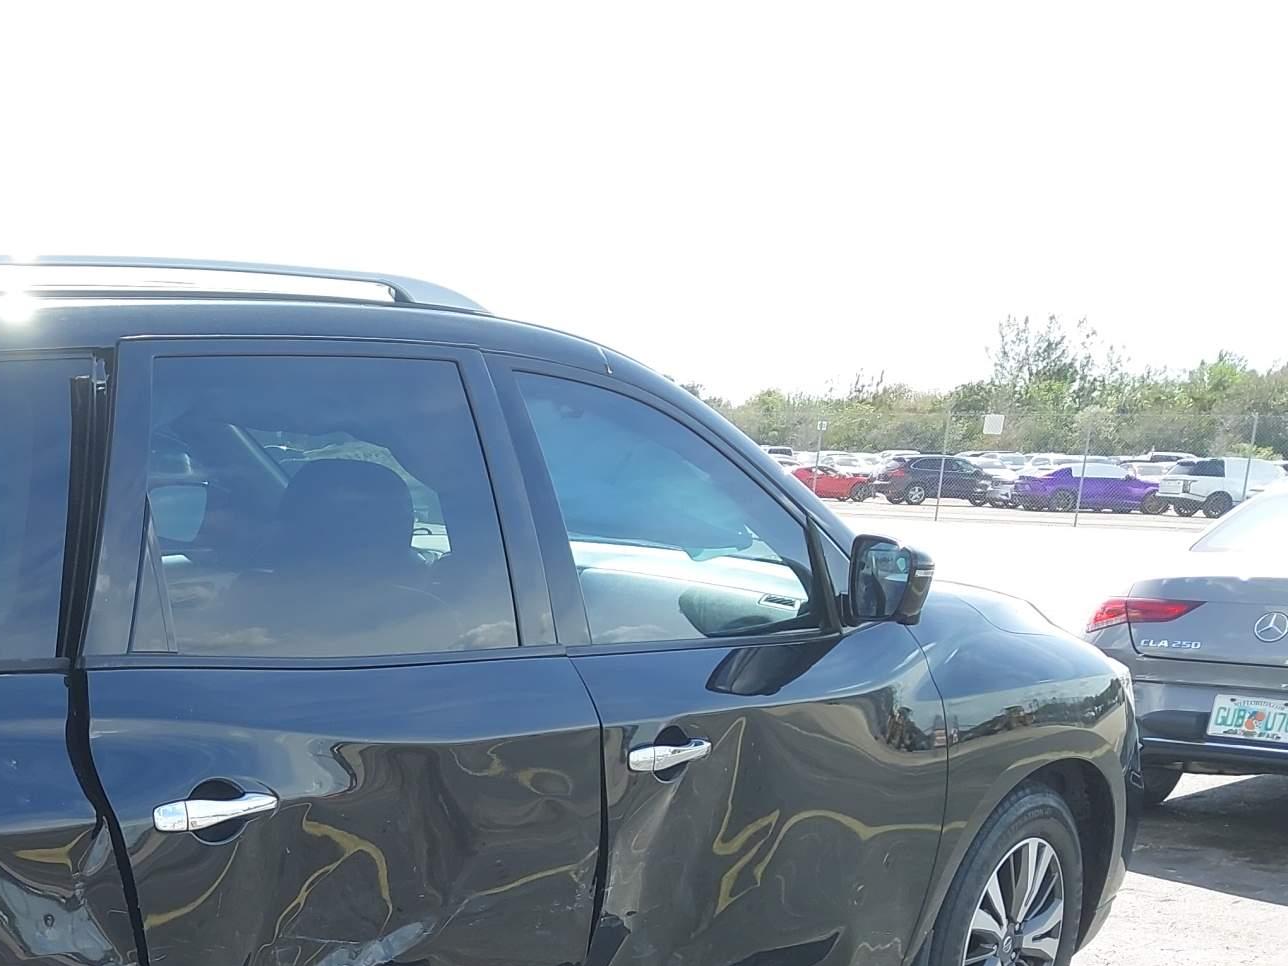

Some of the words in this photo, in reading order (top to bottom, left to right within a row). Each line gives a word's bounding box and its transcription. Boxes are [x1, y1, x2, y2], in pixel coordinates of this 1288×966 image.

[1140, 639, 1169, 649] CLA
[1171, 640, 1201, 649] 250
[1215, 706, 1246, 728] GUB
